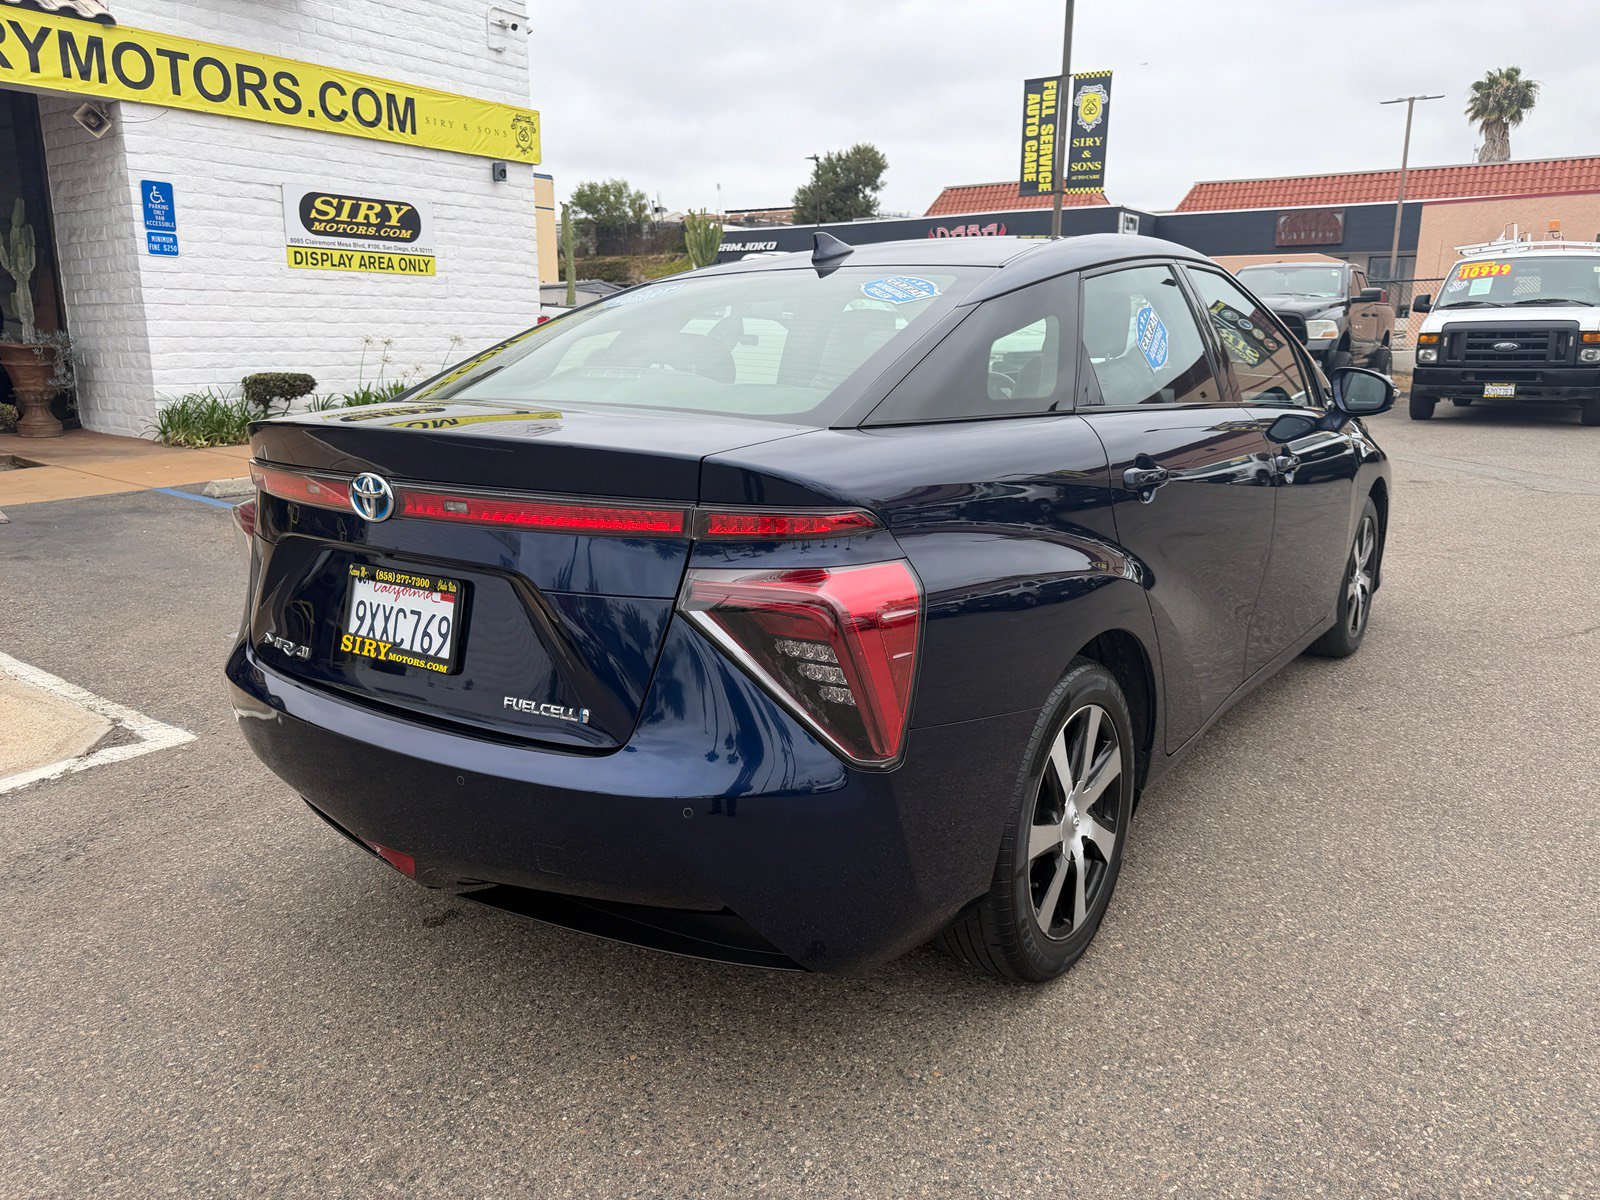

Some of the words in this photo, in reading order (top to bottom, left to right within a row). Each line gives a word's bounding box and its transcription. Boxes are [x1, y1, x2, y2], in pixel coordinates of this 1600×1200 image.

[1041, 80, 1057, 118] FULL
[1025, 93, 1041, 137] AUTO
[425, 117, 455, 129] SIRY
[463, 123, 468, 131] &
[477, 126, 508, 138] SONS
[1072, 136, 1103, 148] SIRY
[1023, 140, 1039, 183] CARE
[1037, 123, 1055, 193] SERVICE
[1081, 150, 1092, 158] &
[1070, 161, 1102, 172] SONS
[148, 203, 169, 211] PARKING
[310, 196, 412, 227] SIRY
[145, 220, 175, 228] ACCESSIBLE
[311, 222, 413, 239] MOTORS.COM
[163, 244, 177, 252] $250
[305, 238, 336, 247] Clairemont
[293, 250, 354, 268] DISPLAY
[358, 254, 395, 271] AREA
[398, 257, 431, 273] ONLY
[375, 569, 395, 583] (858)
[396, 574, 431, 589] 277-7300
[353, 600, 450, 657] 9XXC769
[340, 633, 391, 661] SIRY
[388, 653, 448, 674] MOTORS.COM
